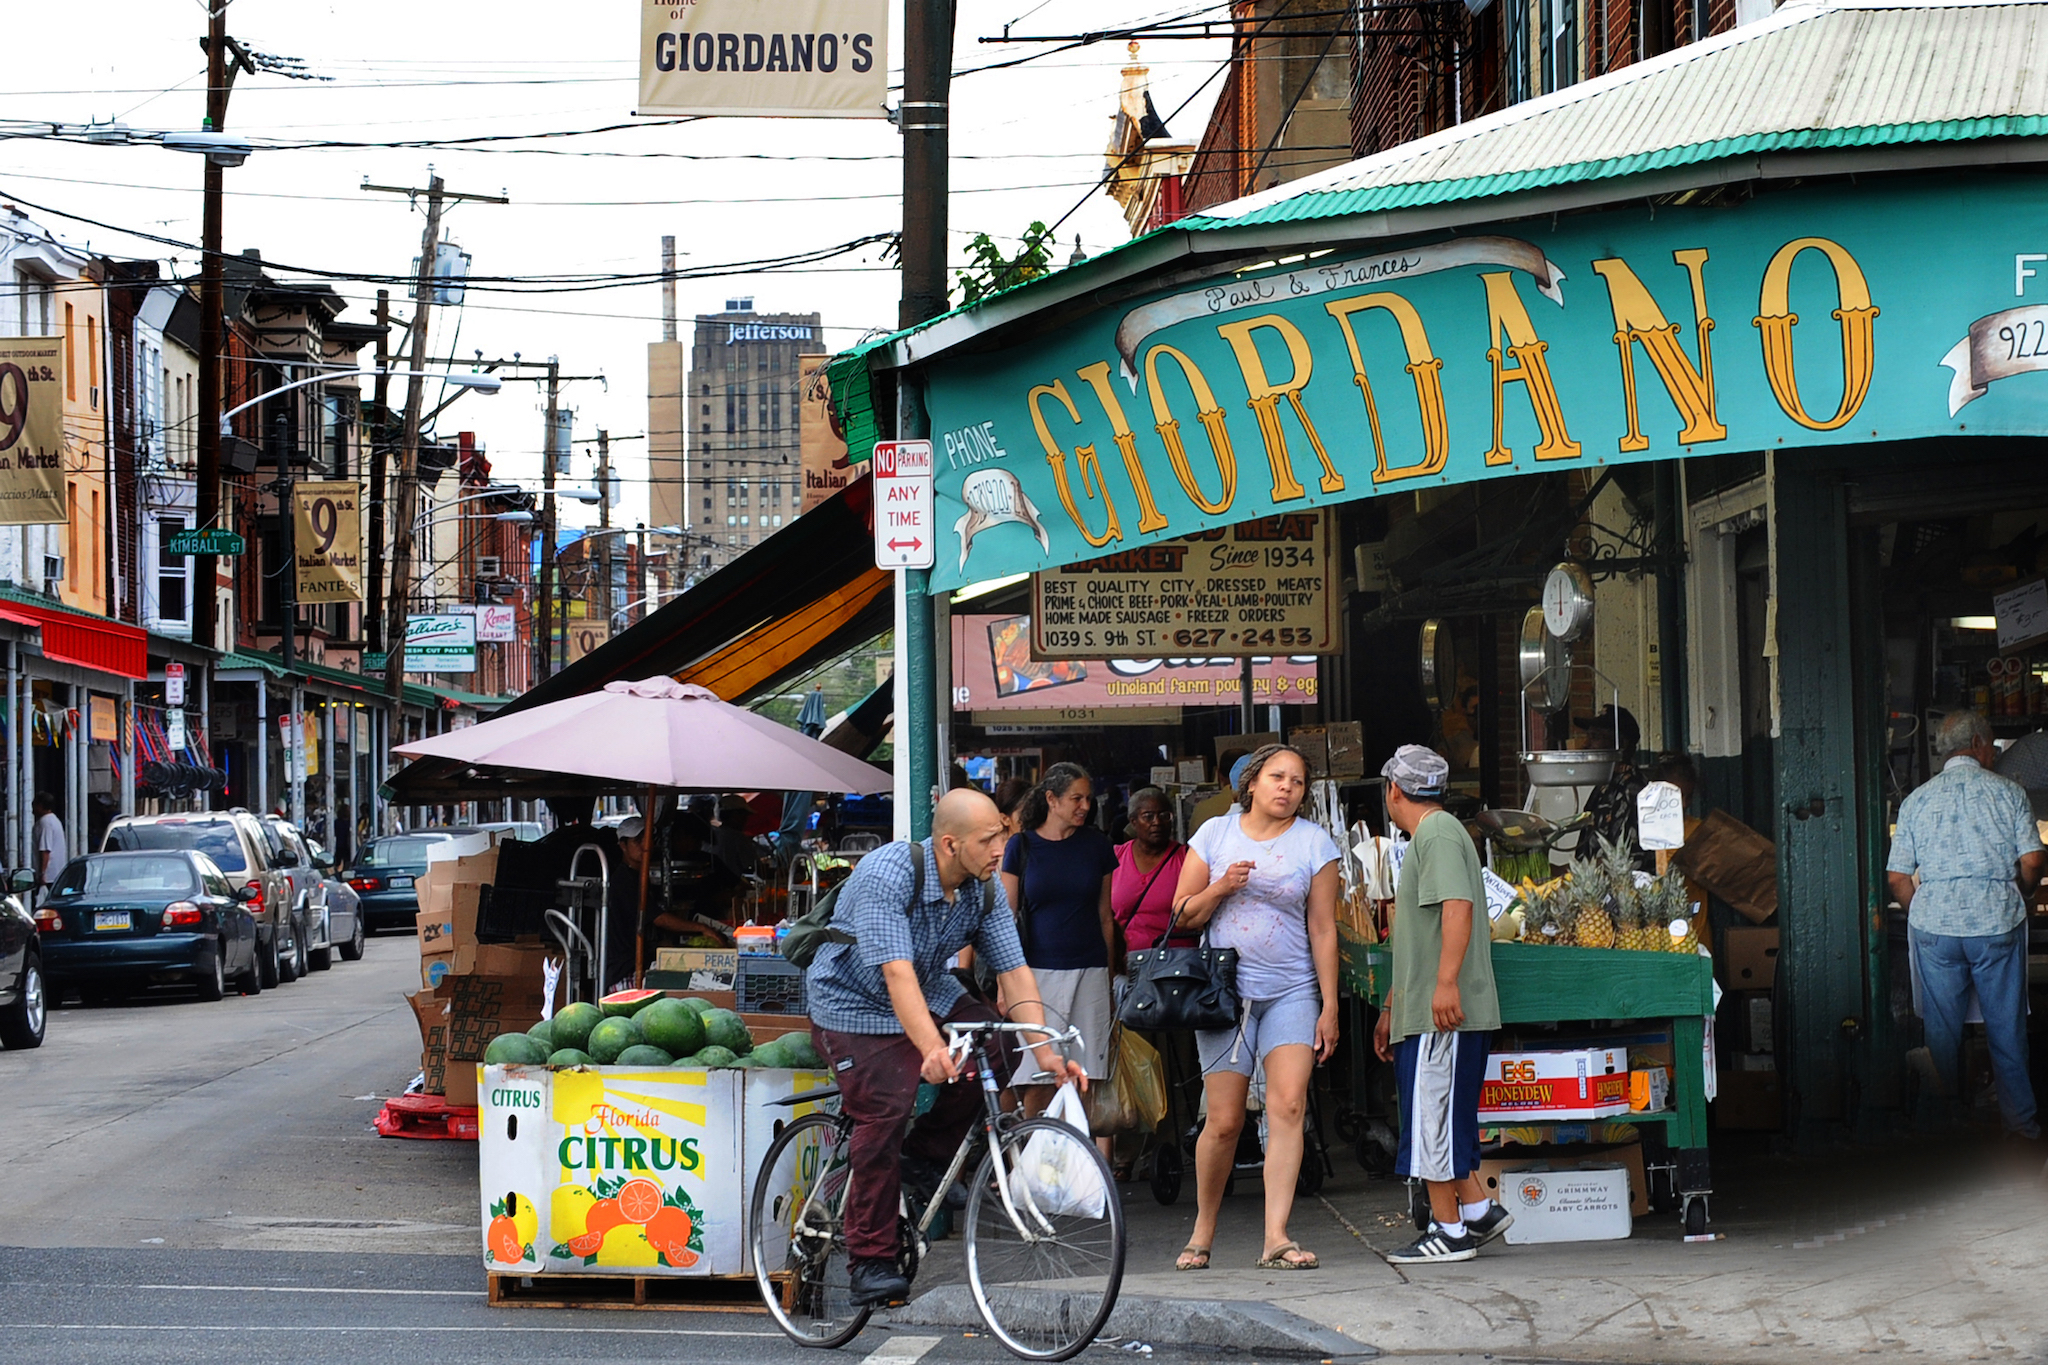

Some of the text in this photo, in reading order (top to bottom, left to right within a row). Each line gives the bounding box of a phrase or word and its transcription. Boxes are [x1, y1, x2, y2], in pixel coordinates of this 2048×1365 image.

[670, 8, 685, 20] of
[656, 32, 873, 73] GIORDANO'S
[1205, 256, 1421, 313] Paul & Frances
[2015, 254, 2047, 296] F
[1025, 236, 1881, 548] GIORDANO
[944, 421, 1007, 470] PHONE
[18, 447, 60, 469] Market
[876, 449, 895, 473] NO
[898, 452, 928, 467] PARKING
[806, 469, 847, 489] Italian
[27, 488, 58, 500] Meats
[887, 486, 920, 501] ANY
[887, 511, 921, 527] TIME
[1234, 513, 1318, 541] MEAT
[170, 538, 240, 553] KIMBALL ST
[1210, 543, 1260, 571] Since
[1264, 547, 1315, 568] 1934
[300, 580, 358, 593] FANTE'S
[1044, 577, 1322, 595] BEST QUALITY CITY DRESSED MEATS
[1045, 592, 1313, 610] PRIME & CHOICE BEEF PORK VEAL LAMB POULTRY
[1045, 609, 1286, 625] HOME MADE SAUSAGE FREEZR ORDERS
[1045, 627, 1313, 648] 1039 S. 9th ST. 627 2453
[1107, 677, 1166, 696] vineland
[1170, 676, 1210, 695] farm
[1215, 677, 1271, 697] poury
[1276, 676, 1290, 695] &
[1059, 710, 1096, 719] 1031
[491, 1088, 541, 1108] CITRUS
[1484, 1084, 1553, 1105] HONEYDEW
[585, 1104, 660, 1135] Florida
[558, 1135, 700, 1171] CITRUS
[1557, 1186, 1609, 1194] GRIMMWAY
[1576, 1203, 1618, 1212] CARROTS
